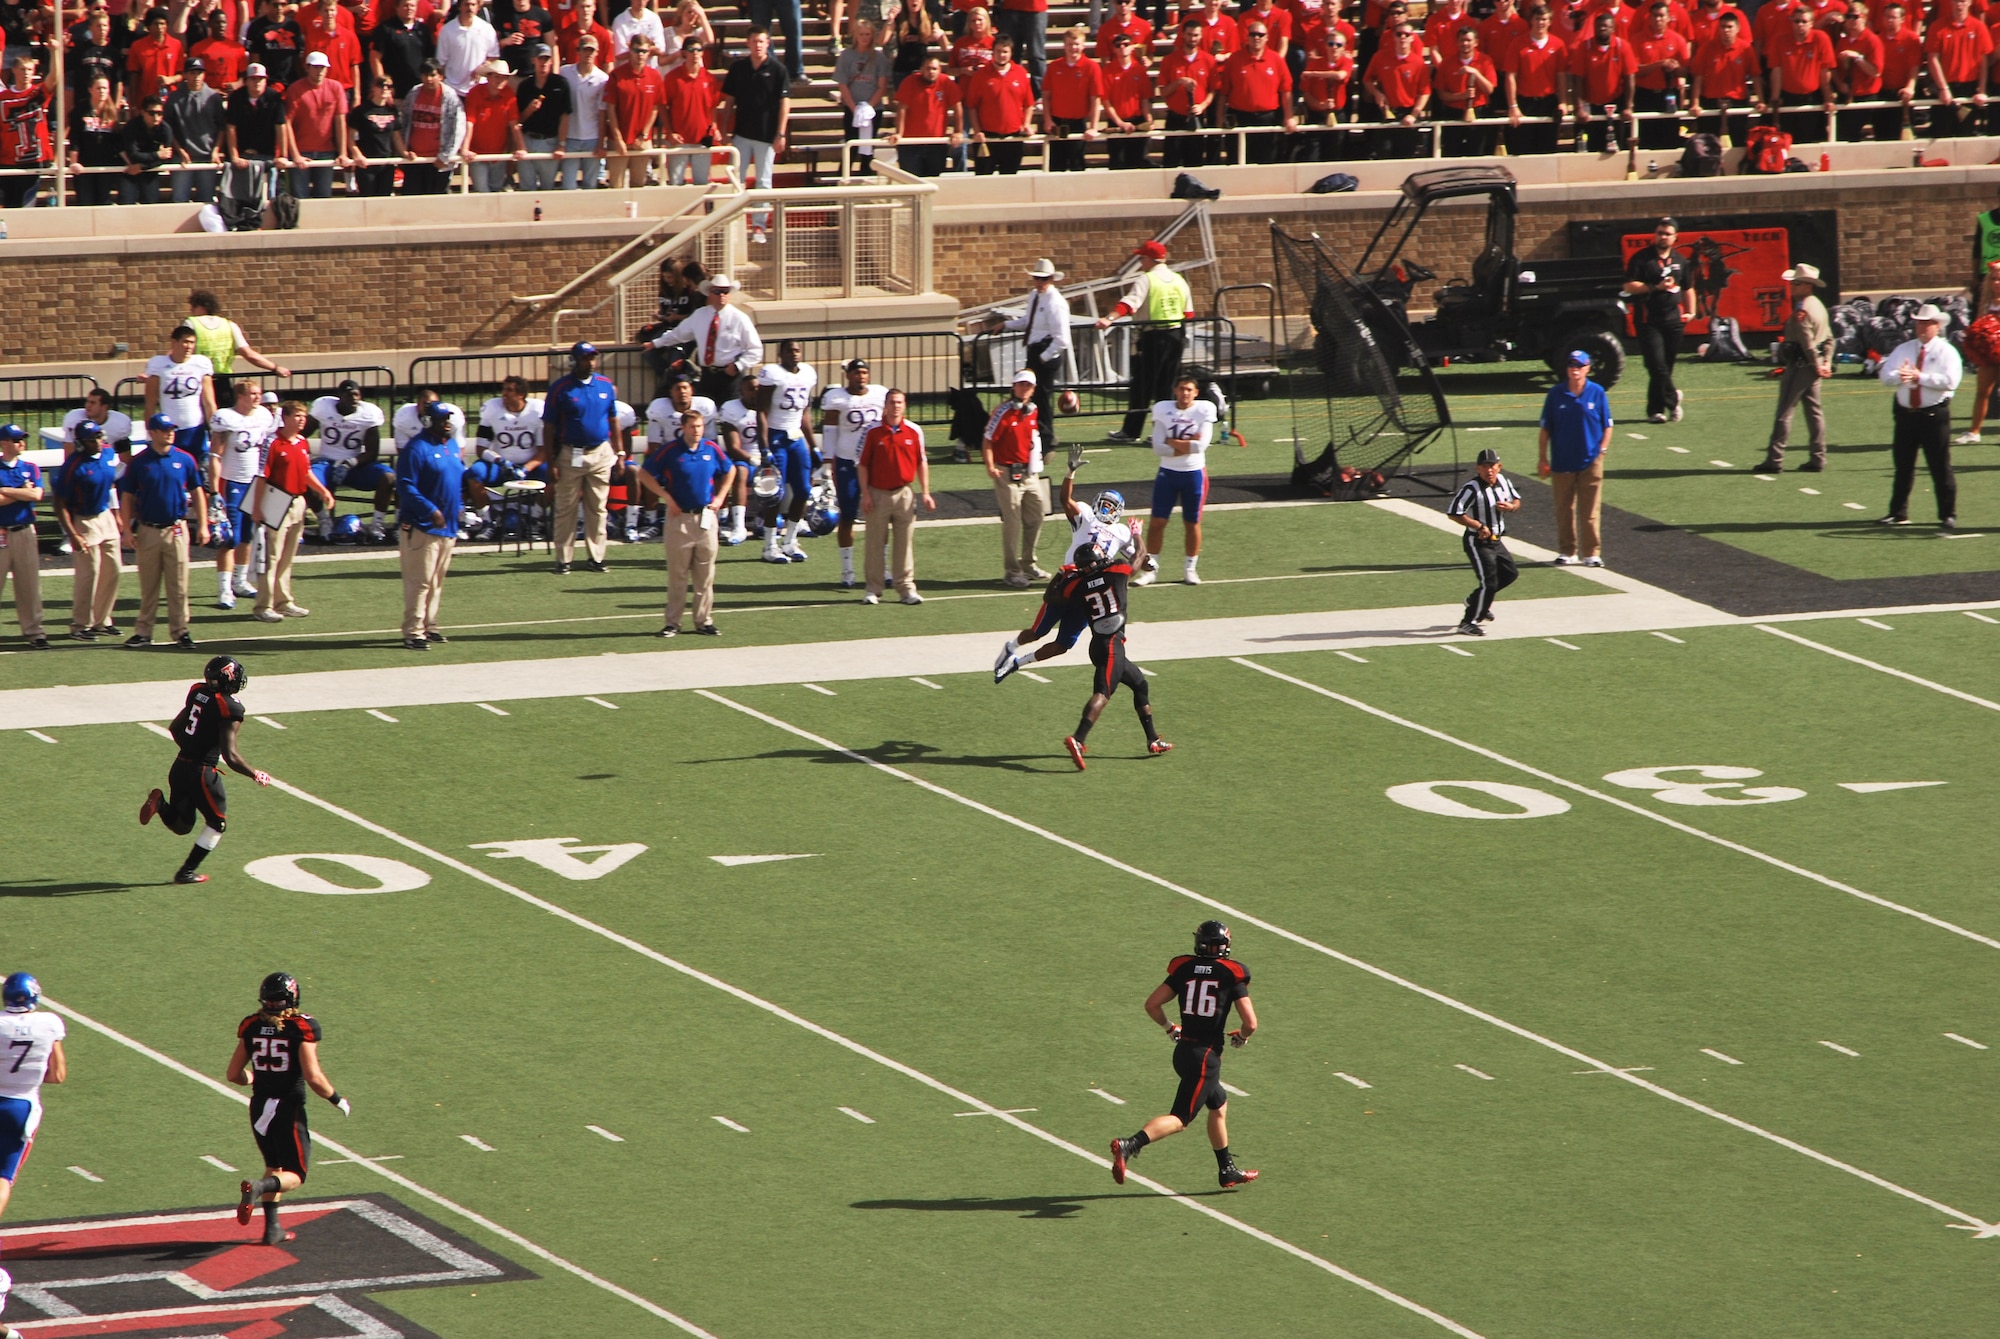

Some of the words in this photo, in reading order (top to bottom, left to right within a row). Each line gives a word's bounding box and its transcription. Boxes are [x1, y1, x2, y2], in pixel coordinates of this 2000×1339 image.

[1743, 231, 1781, 242] TECH
[163, 376, 199, 400] 49
[779, 387, 807, 413] 55
[324, 426, 362, 450] 96
[496, 430, 535, 450] 90
[1167, 423, 1196, 441] 16
[1084, 586, 1119, 621] 31
[184, 702, 202, 736] 5
[1182, 978, 1220, 1019] 16
[9, 1040, 34, 1074] 7
[252, 1037, 290, 1073] 25
